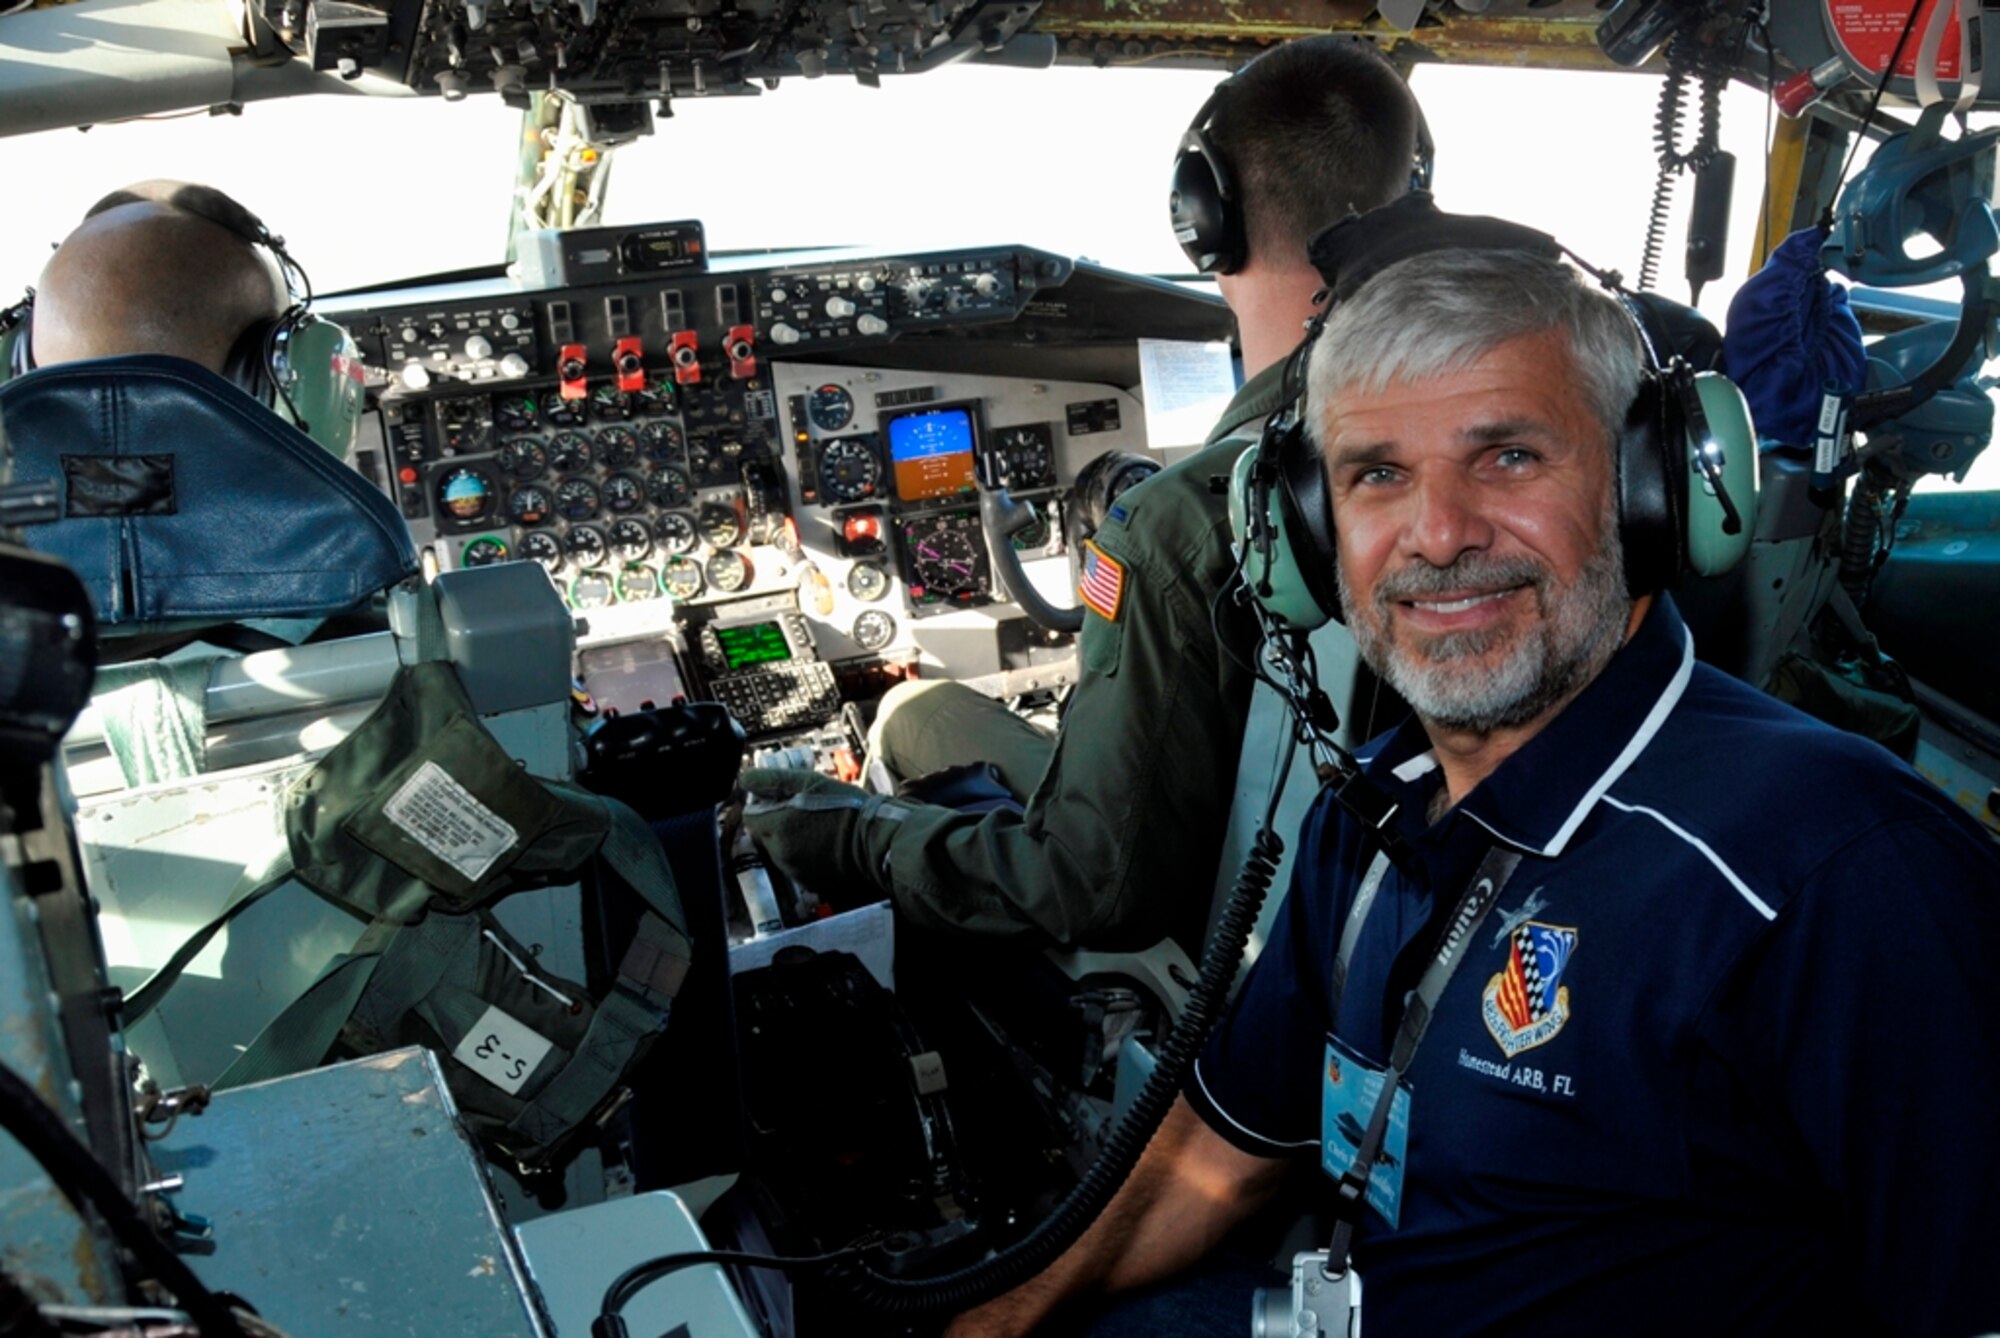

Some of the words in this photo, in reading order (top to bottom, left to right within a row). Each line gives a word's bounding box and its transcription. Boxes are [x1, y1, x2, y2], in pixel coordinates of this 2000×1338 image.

[1437, 877, 1494, 967] Canon
[1534, 1010, 1563, 1041] WING
[474, 1033, 527, 1080] S-3
[1458, 1047, 1511, 1080] Homestead
[1511, 1066, 1548, 1094] ARB,
[1552, 1074, 1576, 1097] FL
